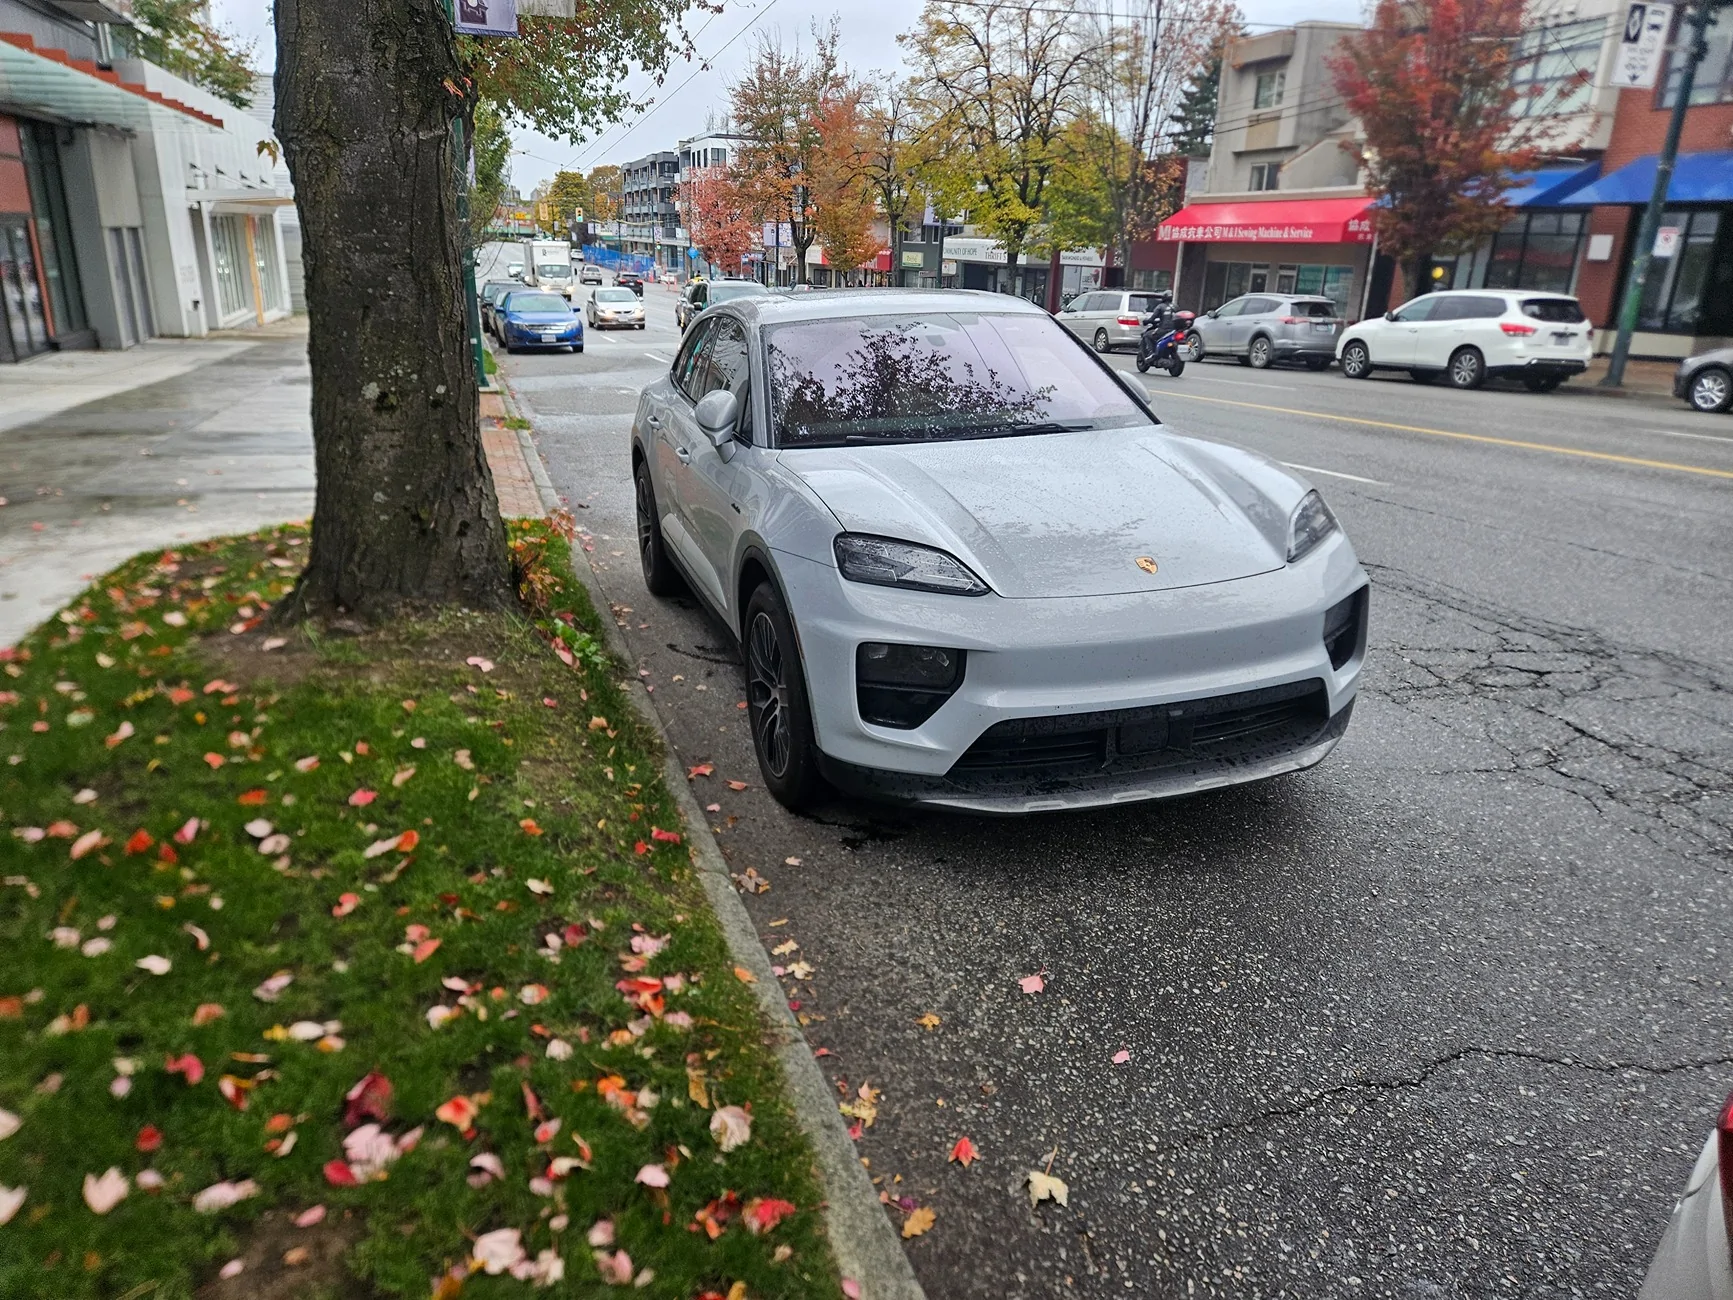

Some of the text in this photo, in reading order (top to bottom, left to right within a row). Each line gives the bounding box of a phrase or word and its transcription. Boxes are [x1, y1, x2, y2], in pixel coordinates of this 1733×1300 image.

[1238, 227, 1258, 240] Sewing
[1258, 226, 1282, 239] Machine
[1283, 226, 1289, 238] &
[1289, 226, 1313, 239] Service
[985, 252, 1002, 260] THRIFT
